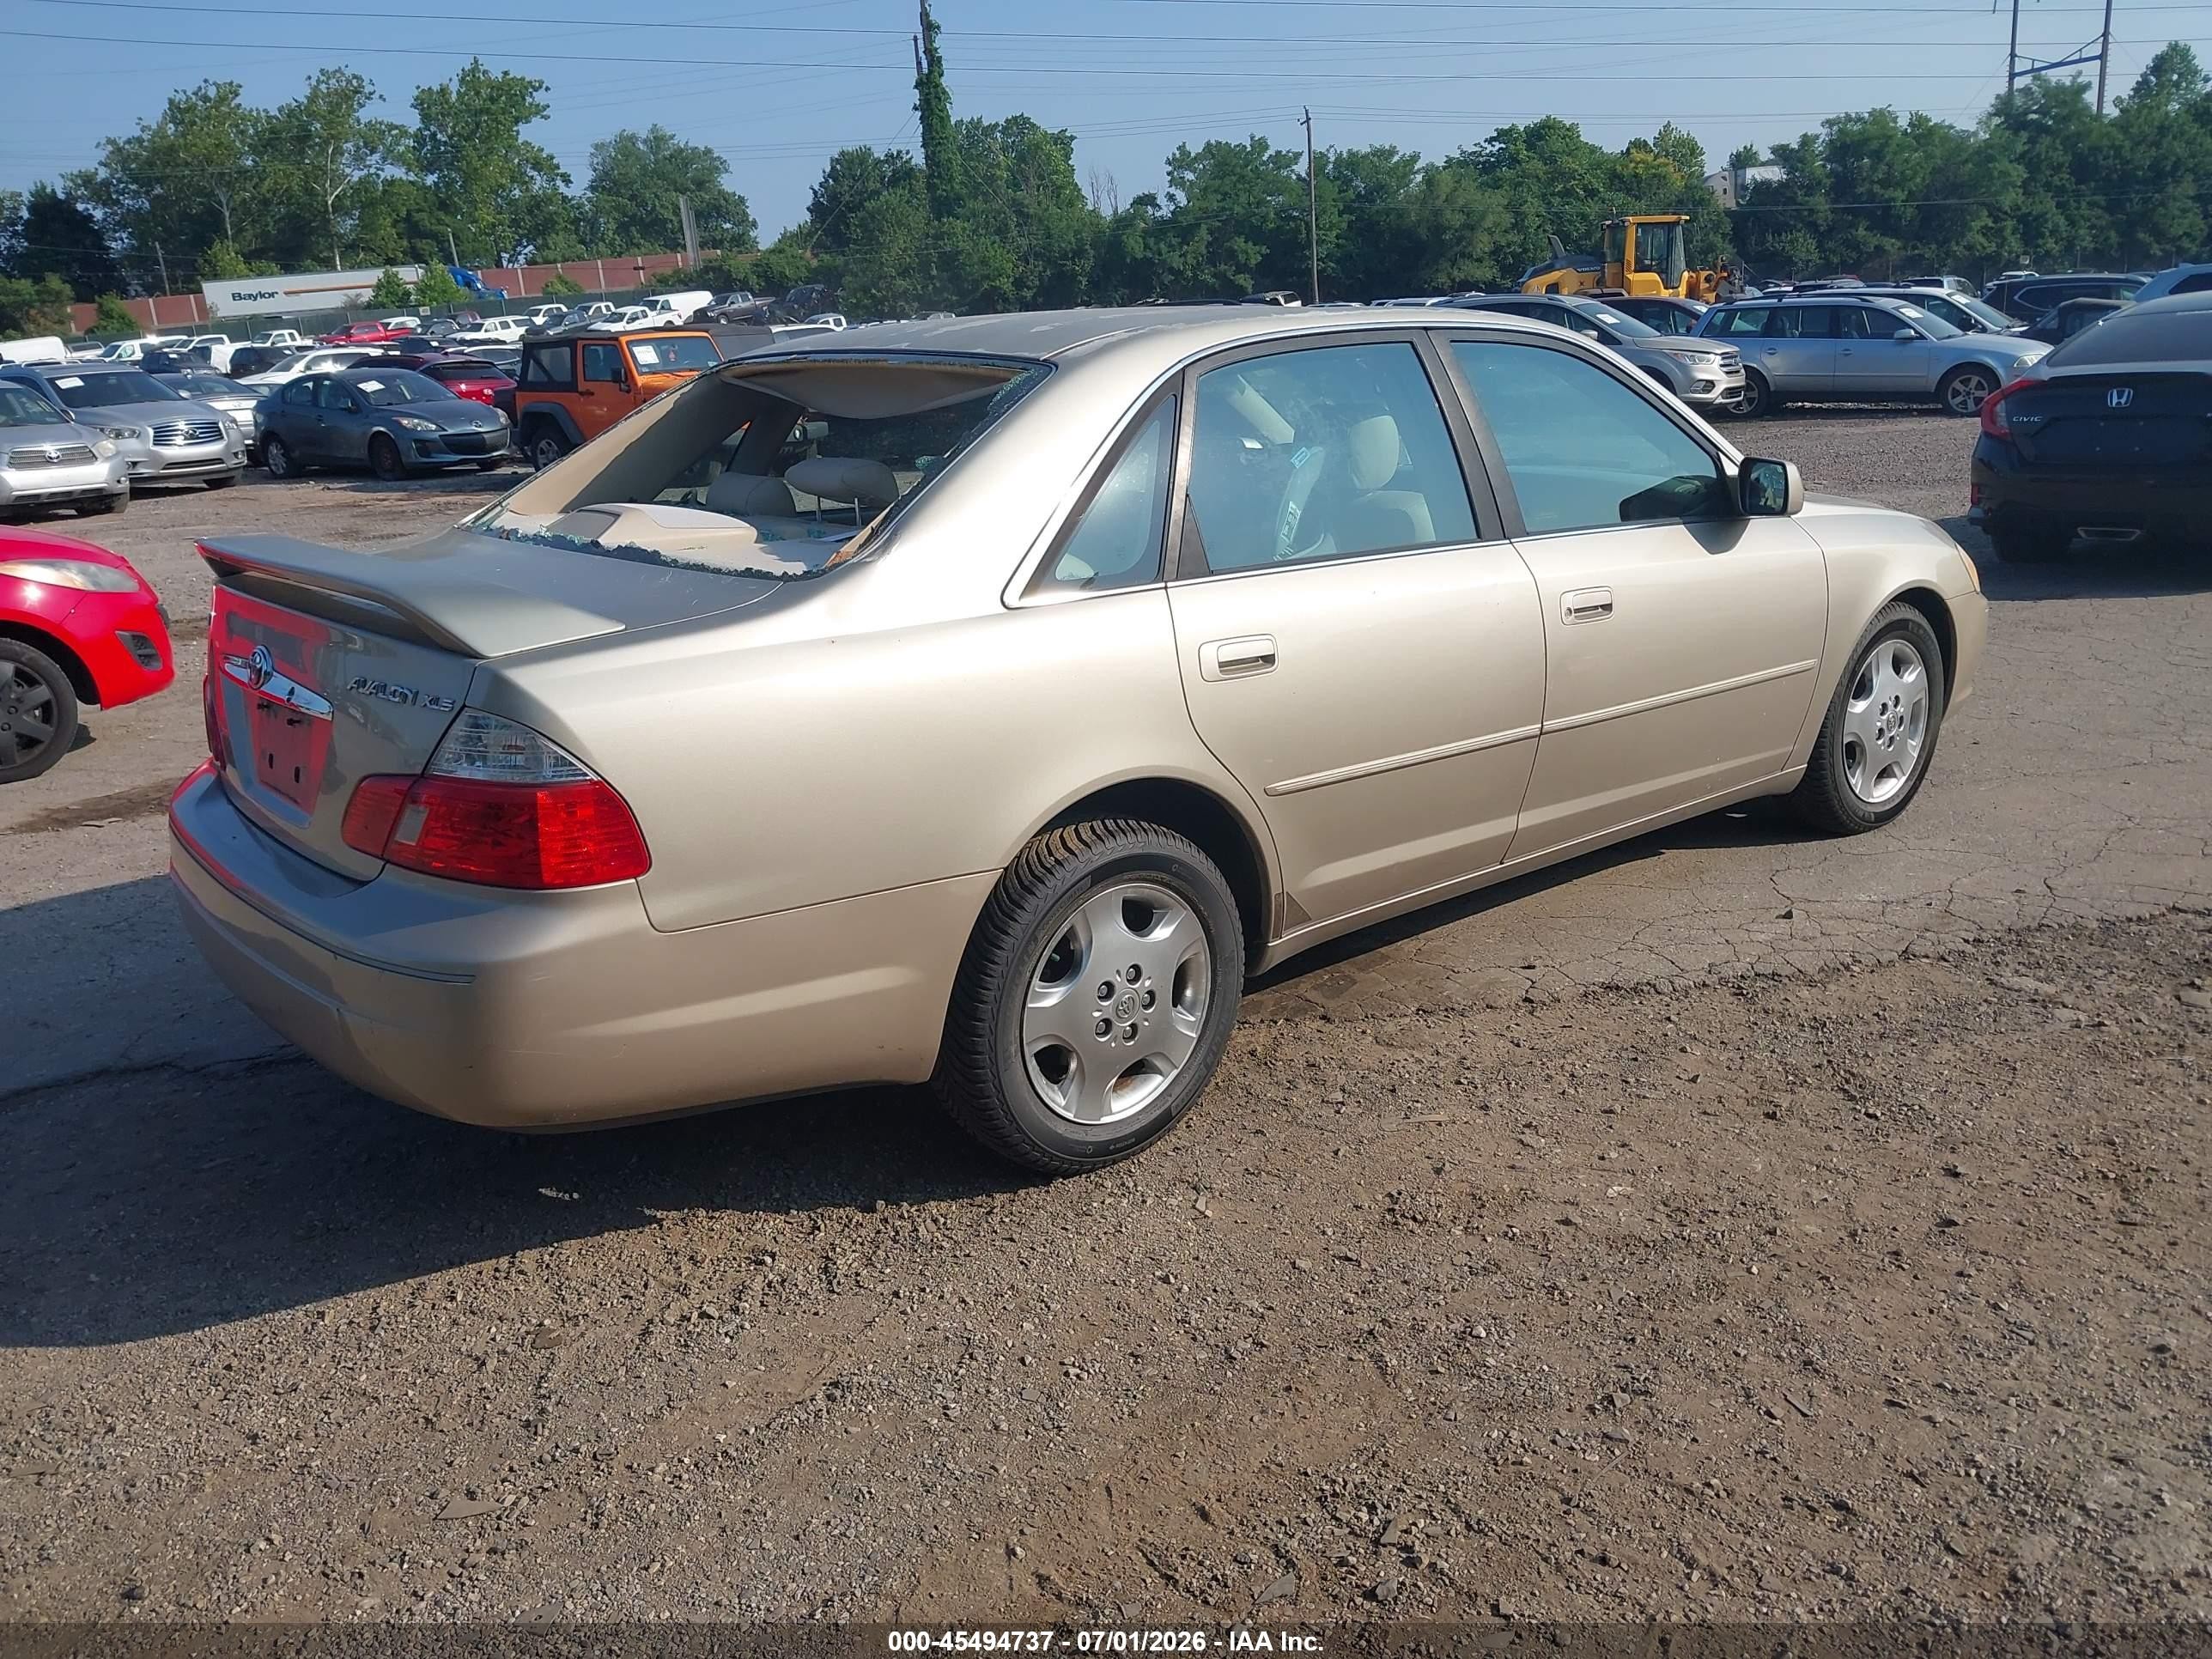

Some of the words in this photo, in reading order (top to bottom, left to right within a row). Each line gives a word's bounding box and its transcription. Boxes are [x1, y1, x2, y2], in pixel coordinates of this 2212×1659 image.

[231, 290, 279, 302] Baylor
[347, 677, 419, 706] AVALON
[421, 694, 457, 712] XLS
